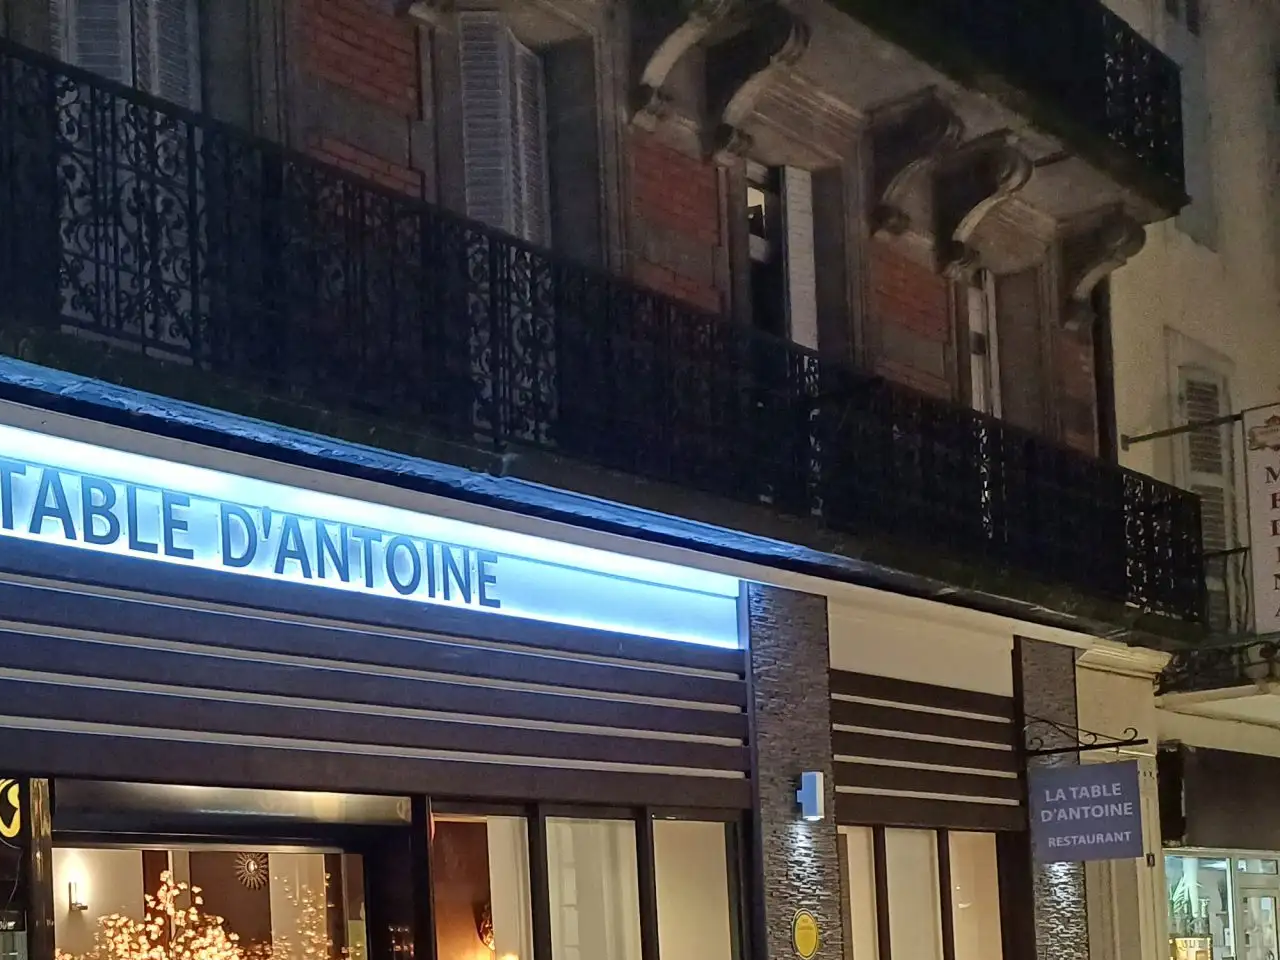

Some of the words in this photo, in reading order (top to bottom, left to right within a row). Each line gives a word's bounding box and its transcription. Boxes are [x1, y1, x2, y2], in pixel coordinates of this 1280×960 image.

[220, 501, 501, 609] D'ANTOINE
[1045, 787, 1067, 802] LA
[1069, 782, 1122, 800] TABLE
[1040, 802, 1133, 822] D'ANTOINE
[1048, 831, 1132, 848] RESTAURANT
